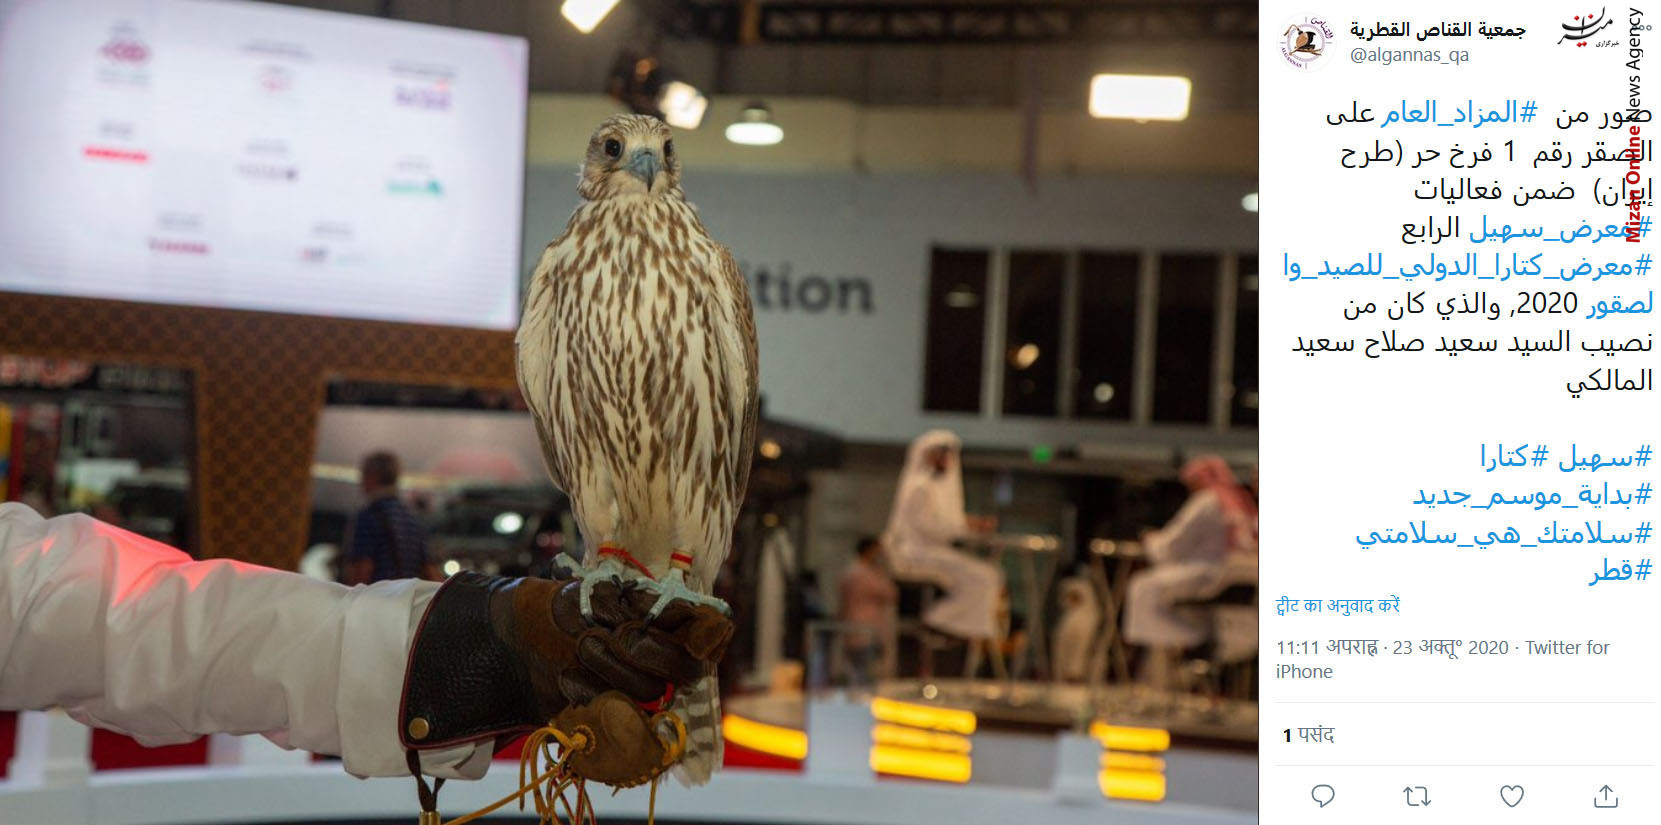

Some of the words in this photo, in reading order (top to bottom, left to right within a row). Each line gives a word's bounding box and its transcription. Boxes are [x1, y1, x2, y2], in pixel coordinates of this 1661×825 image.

[1350, 22, 1410, 41] القطرية
[1416, 22, 1471, 41] القناص
[1478, 22, 1526, 39] جمعية
[1351, 47, 1469, 65] @algannas_qa
[1327, 101, 1374, 125] على
[1381, 100, 1538, 128] #المزاد_العام
[1556, 110, 1589, 129] من
[1341, 140, 1403, 168] (طرح
[1411, 150, 1440, 168] حر
[1450, 143, 1492, 168] فرخ
[1504, 140, 1513, 161] 1
[1533, 144, 1572, 168] رقم
[1415, 178, 1502, 204] فعاليات
[1513, 182, 1575, 206] ضمن
[1402, 216, 1459, 244] الرابع
[1285, 253, 1653, 281] #معرض_كتارا_الدولي_للصيد_وا
[742, 260, 875, 315] tion
[1344, 301, 1376, 320] من
[1388, 291, 1425, 320] كان
[1436, 292, 1500, 320] والذي
[1510, 292, 1578, 317] 2020,
[1586, 291, 1653, 319] لصقور
[1292, 337, 1354, 356] سعيد
[1365, 330, 1424, 358] صلاح
[1435, 337, 1497, 356] سعيد
[1508, 330, 1570, 356] السيد
[1581, 334, 1652, 356] نصيب
[1567, 368, 1652, 398] المالكي
[1482, 444, 1549, 472] #كتارا
[1559, 444, 1653, 472] #سهيل
[1413, 482, 1653, 510] #بداية_موسم_جديد
[1356, 520, 1653, 549] #سلامتك_هي_سلامتي
[1589, 558, 1653, 586] #قطر
[1304, 600, 1323, 612] का
[1327, 600, 1374, 616] अनुवाद
[1378, 595, 1400, 612] करें
[1277, 640, 1319, 655] 11:11
[1393, 641, 1412, 654] 23
[1469, 641, 1508, 654] 2020
[1525, 640, 1581, 654] Twitter
[1587, 640, 1610, 654] for
[1277, 664, 1333, 678] iPhone
[1283, 728, 1292, 743] 1
[1297, 725, 1335, 743] पसंद
